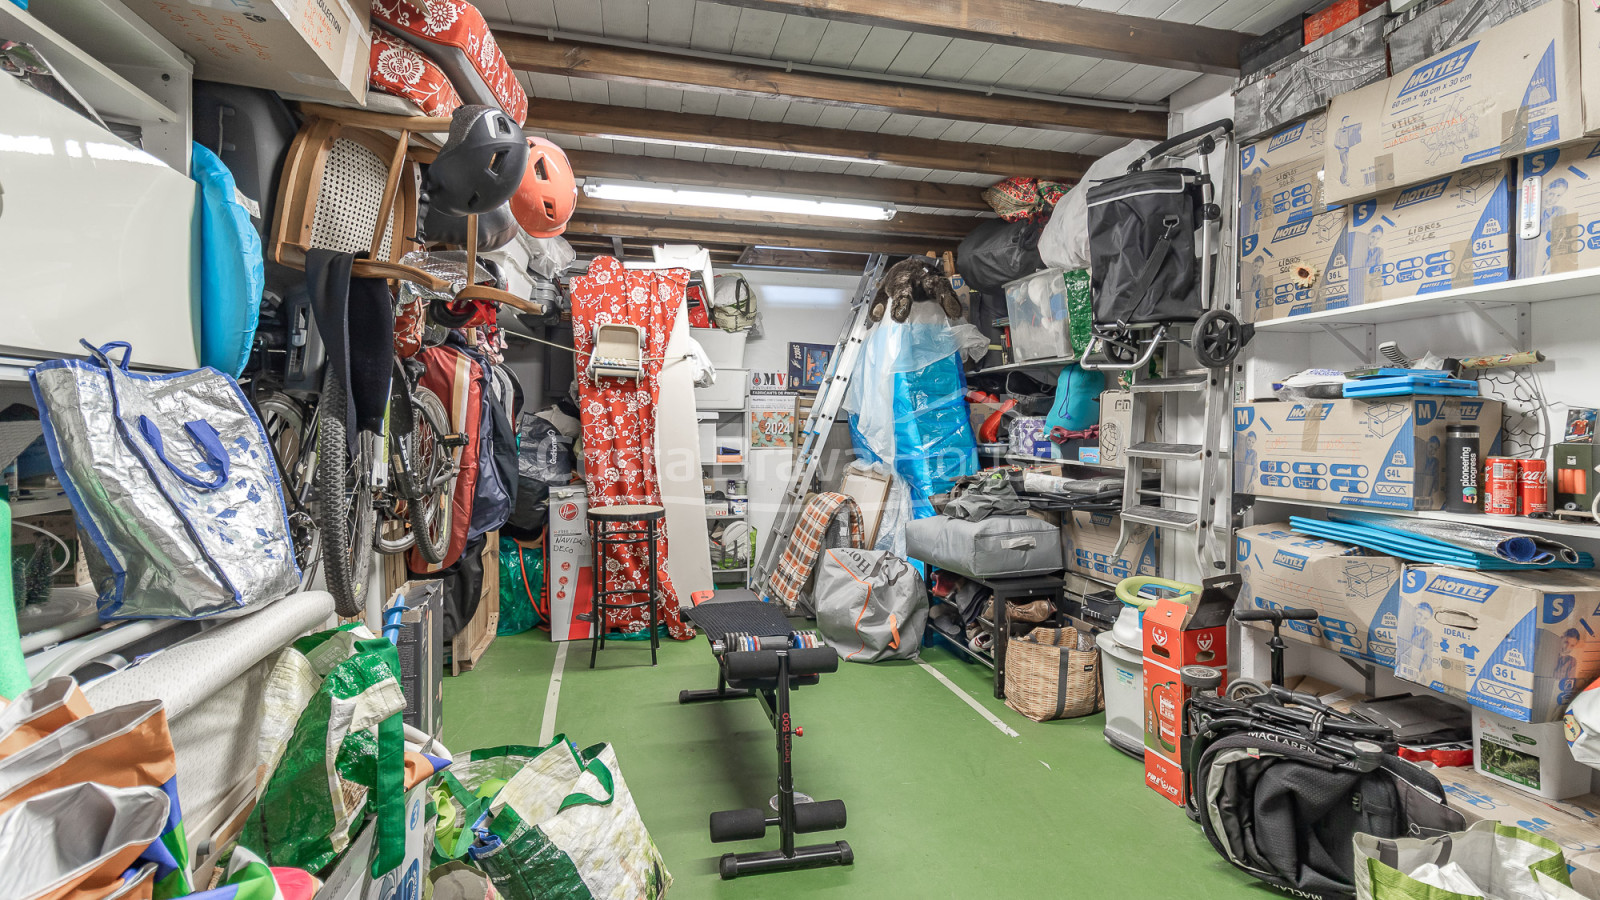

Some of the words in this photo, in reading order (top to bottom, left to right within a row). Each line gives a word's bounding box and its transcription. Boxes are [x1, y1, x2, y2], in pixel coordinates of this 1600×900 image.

[1403, 51, 1471, 90] MOTTEZ
[1430, 85, 1441, 95] cm
[1448, 78, 1459, 88] 30
[1460, 73, 1472, 83] cm
[1243, 150, 1251, 164] S
[1531, 154, 1545, 173] S
[1398, 182, 1444, 206] MOTTEZ
[1358, 204, 1368, 220] S
[1275, 223, 1308, 240] MOTTEZ
[1408, 222, 1442, 236] LIBROS
[1245, 238, 1252, 251] S
[1476, 241, 1487, 251] 36
[1329, 271, 1337, 280] 36
[1237, 410, 1249, 425] M
[1418, 404, 1431, 419] M
[765, 422, 790, 435] 2024
[1462, 447, 1472, 487] pioneering
[1469, 453, 1477, 487] progress
[1239, 540, 1248, 553] M
[1275, 552, 1305, 568] MOTTEZ
[1406, 572, 1417, 588] S
[1431, 579, 1491, 598] MOTTEZ
[1551, 598, 1564, 616] S
[1377, 630, 1388, 639] 54
[1443, 627, 1466, 639] IDEAL
[1495, 666, 1508, 679] 36
[1510, 670, 1516, 681] L
[782, 712, 790, 732] 500
[1248, 731, 1317, 754] MACLAREN
